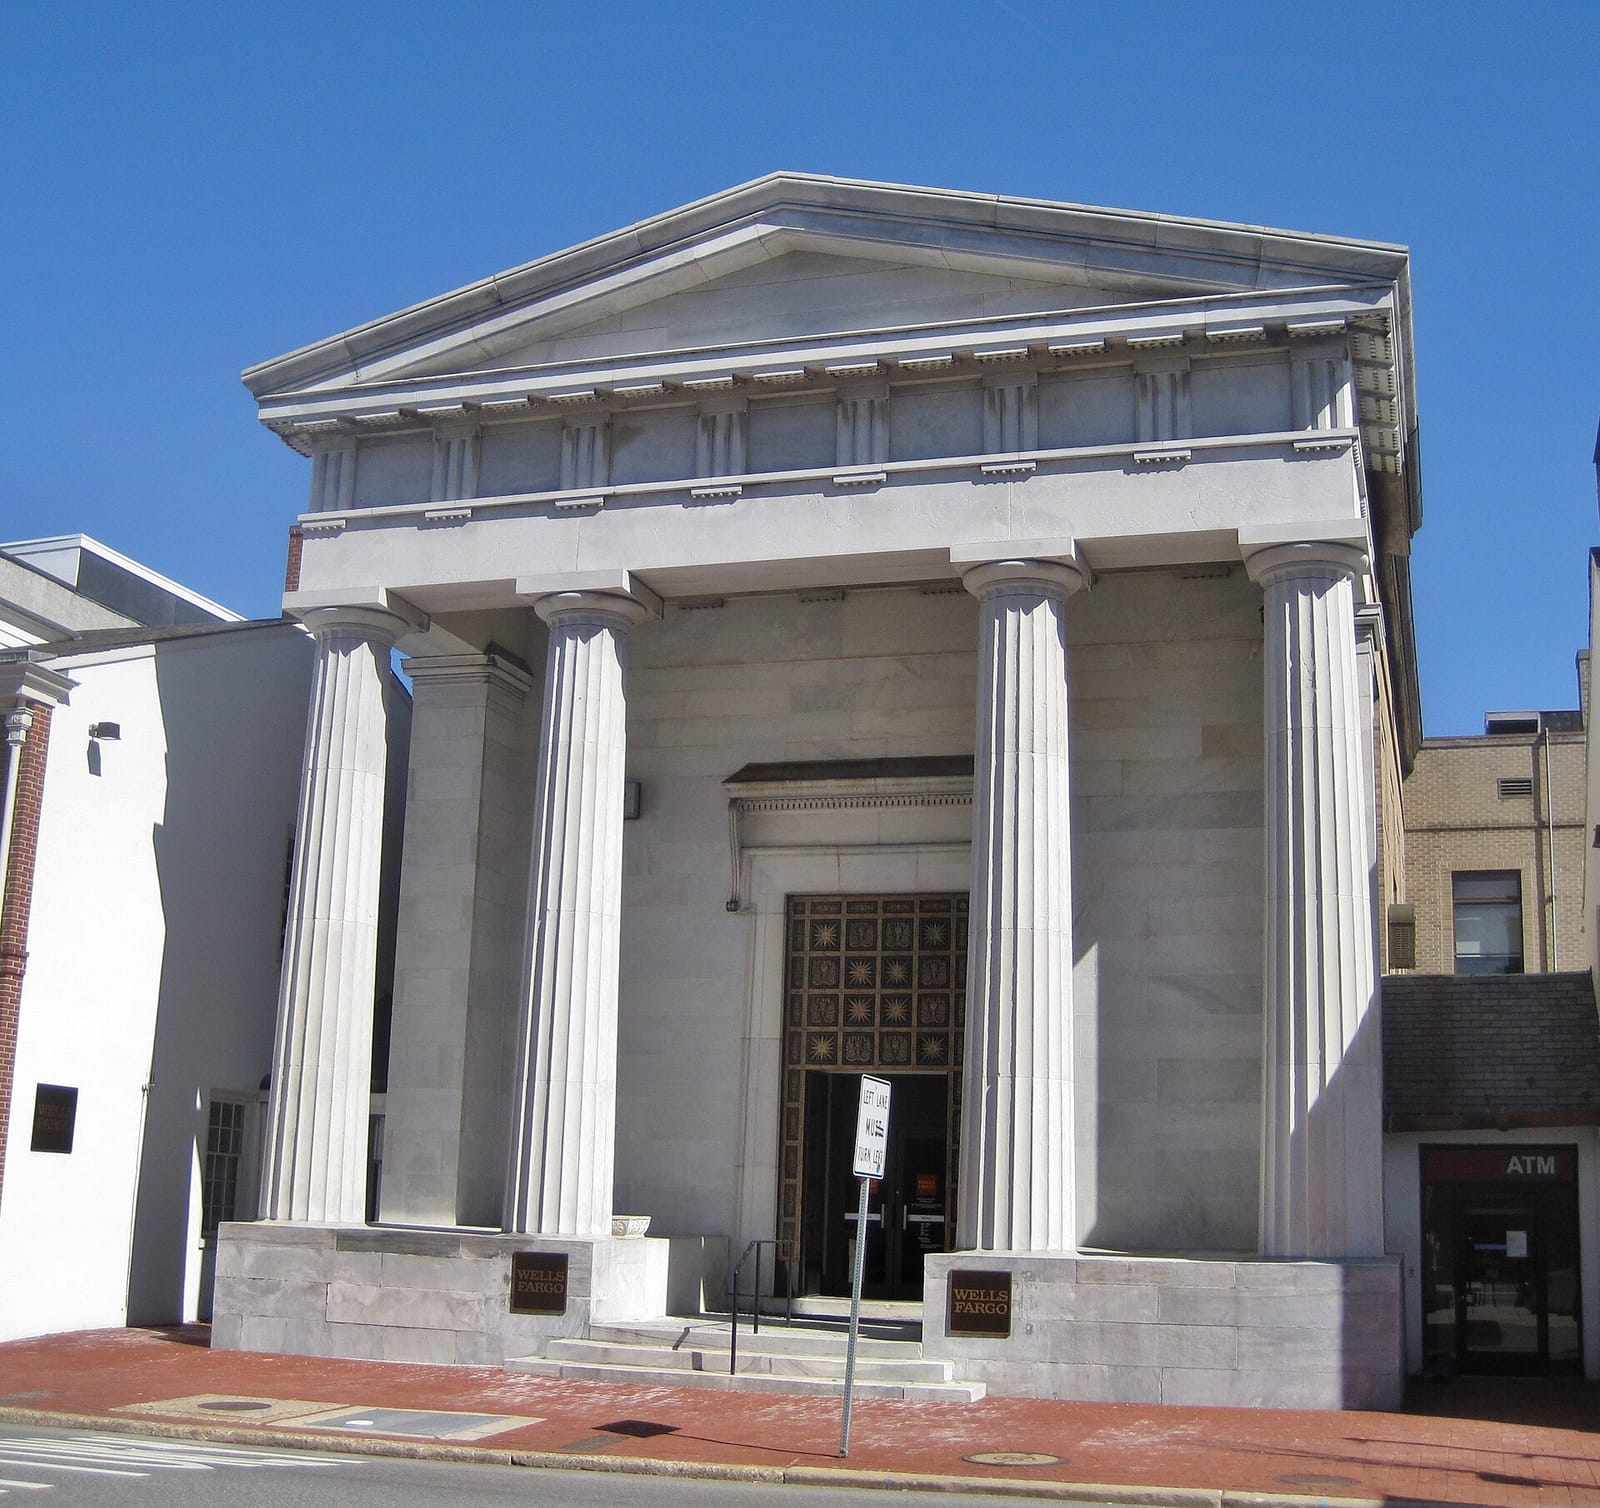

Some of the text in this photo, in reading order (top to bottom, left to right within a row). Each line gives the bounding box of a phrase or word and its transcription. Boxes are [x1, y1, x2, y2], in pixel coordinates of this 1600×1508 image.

[863, 1089, 888, 1109] LEFT LANE
[1506, 1156, 1555, 1174] ATM
[517, 1270, 565, 1281] WELLS
[518, 1281, 564, 1293] FARGO
[954, 1289, 1008, 1301] WELLS
[954, 1302, 1007, 1314] FARGO
